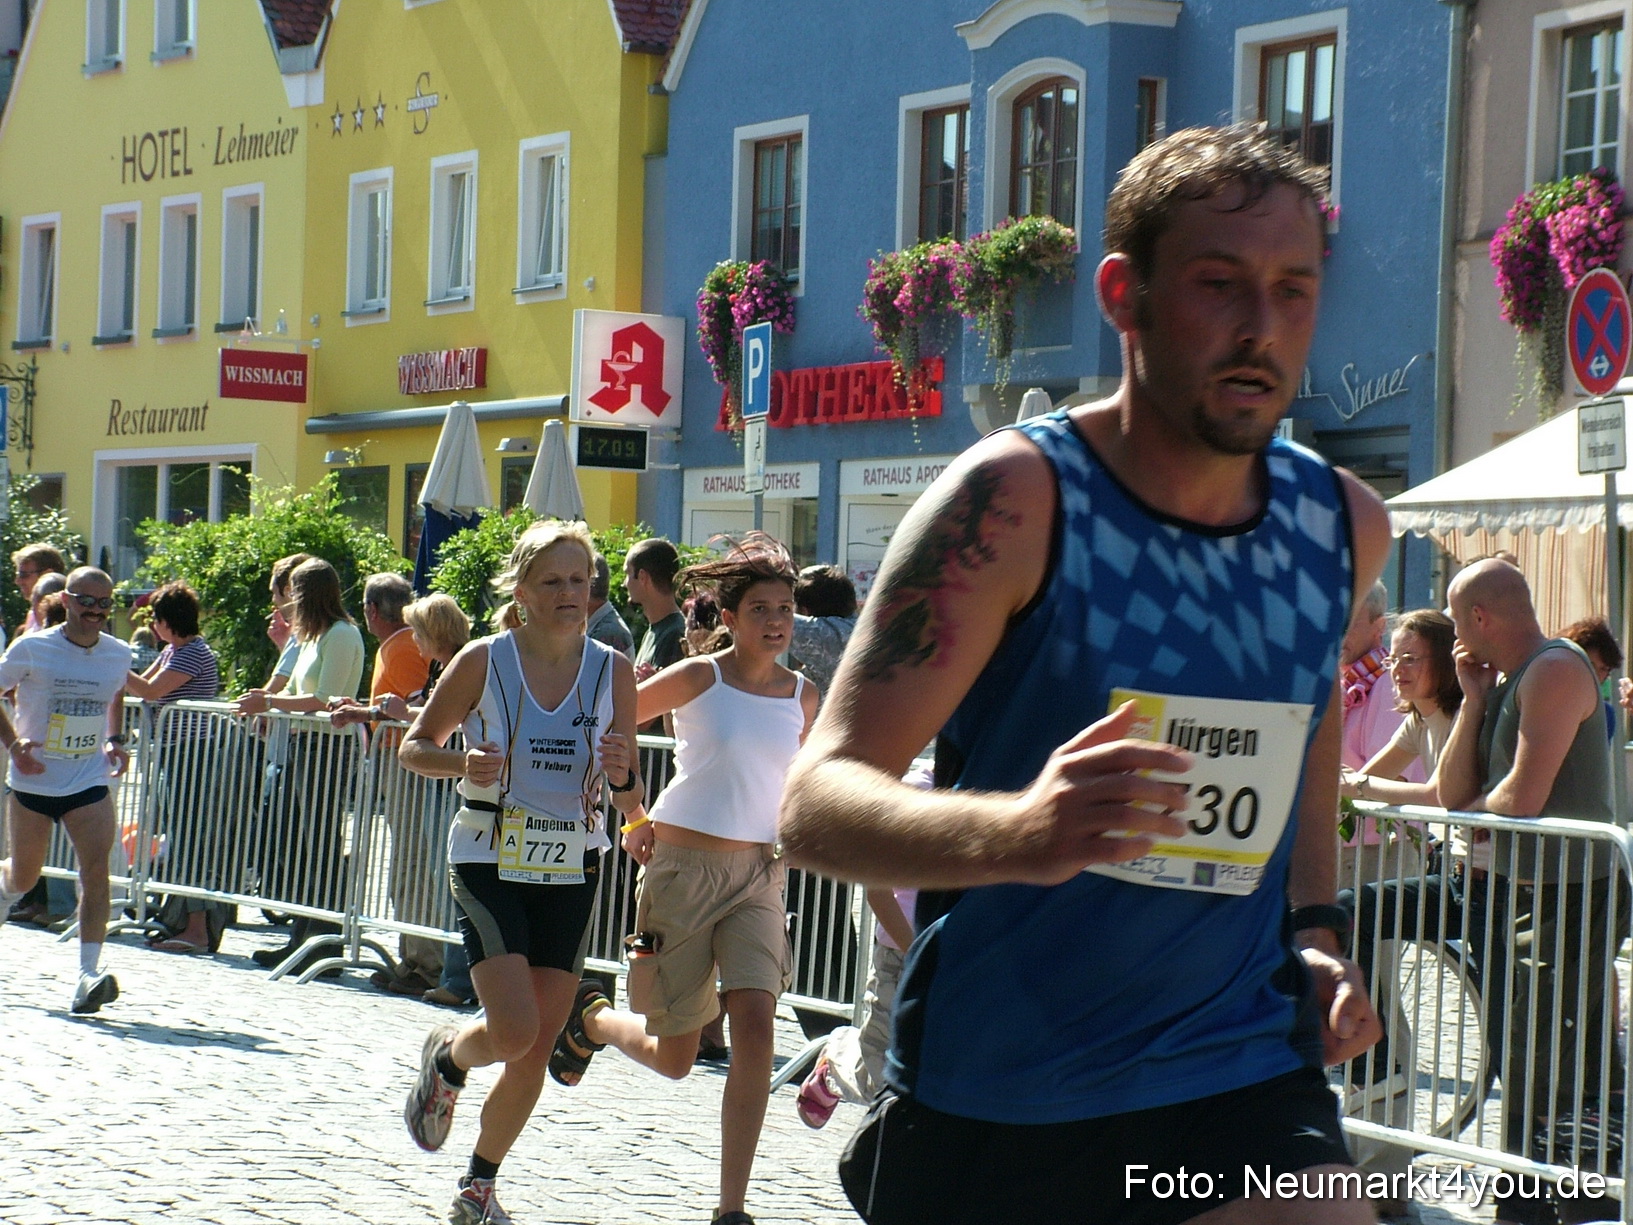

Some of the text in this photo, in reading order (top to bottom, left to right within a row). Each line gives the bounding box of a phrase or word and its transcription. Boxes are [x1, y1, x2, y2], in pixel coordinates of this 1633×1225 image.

[122, 117, 299, 184] HOTEL Lehmeier
[225, 364, 304, 388] WISSMACH
[398, 347, 480, 395] WISSMACH
[749, 337, 764, 405] P
[714, 358, 943, 432] AOTHEKE
[1339, 354, 1420, 420] Sinner
[106, 399, 209, 437] Restaurant
[703, 474, 745, 494] RATHAUS
[764, 471, 800, 491] OTHEKE
[863, 465, 912, 486] RATHAUS
[64, 734, 97, 748] 1155
[536, 738, 577, 748] INTERSPORT
[531, 760, 572, 774] TV Velburg
[526, 816, 576, 832] Angelika
[505, 835, 567, 863] A 772
